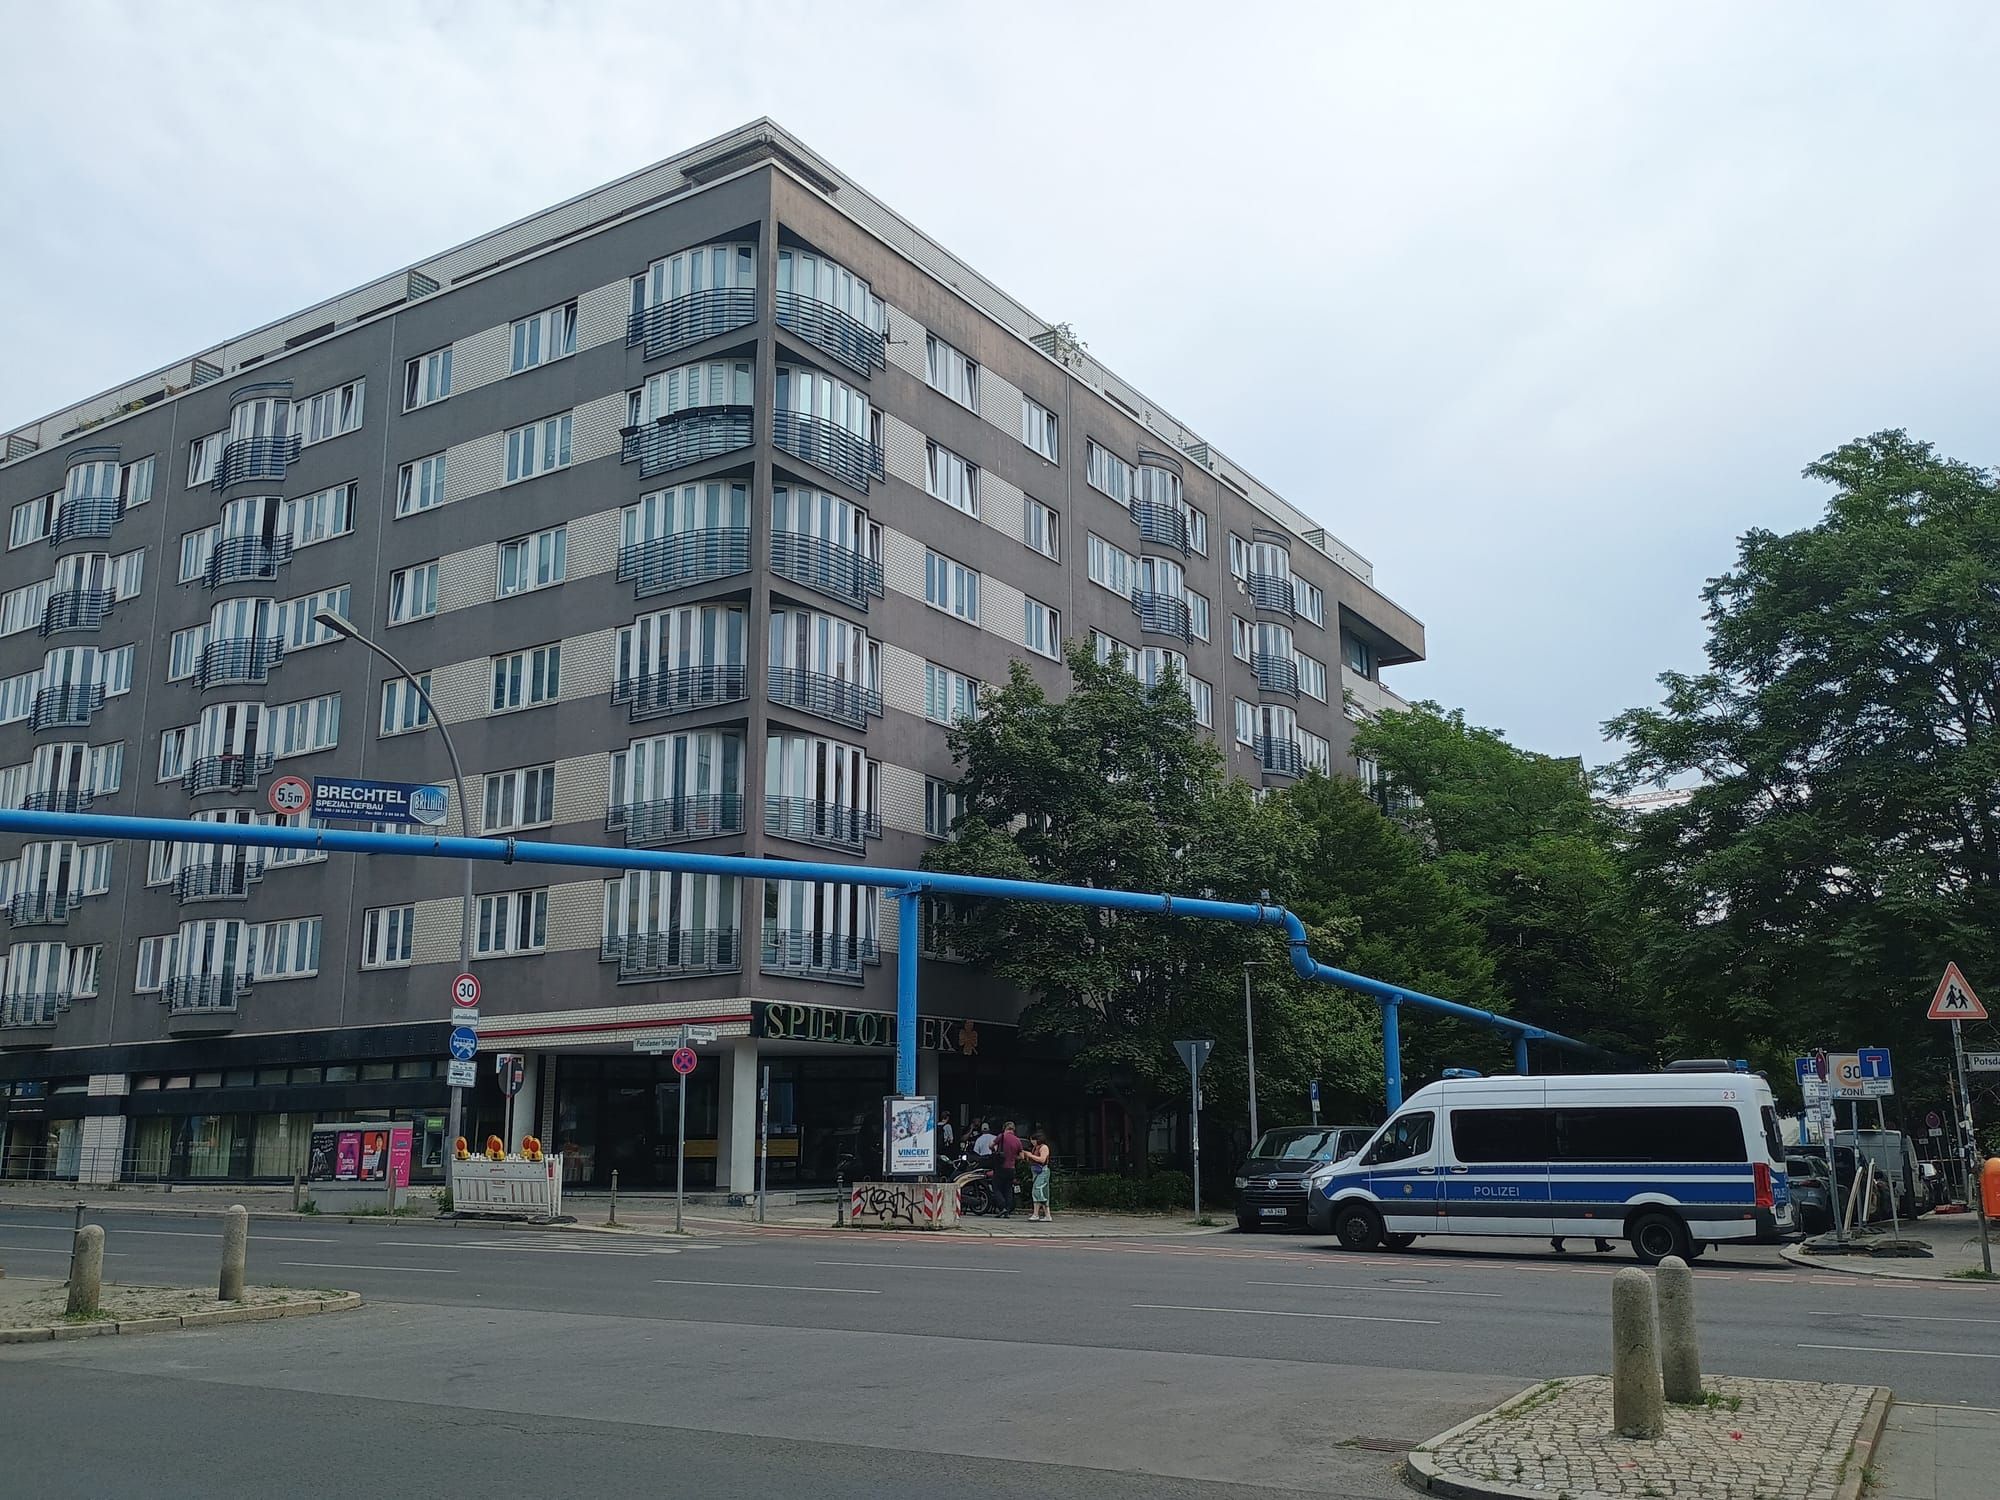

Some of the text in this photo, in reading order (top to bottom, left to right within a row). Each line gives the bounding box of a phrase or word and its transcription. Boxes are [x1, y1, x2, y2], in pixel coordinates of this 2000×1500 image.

[317, 785, 407, 804] BRECHTEL
[315, 799, 384, 811] SPEZIALTIEFBAU
[459, 983, 475, 998] 30
[764, 1003, 956, 1052] SPIELOTEK
[1843, 1065, 1861, 1079] 30
[1723, 1091, 1736, 1099] 23
[898, 1148, 930, 1157] VINCENT
[1473, 1186, 1520, 1197] POLIZEI
